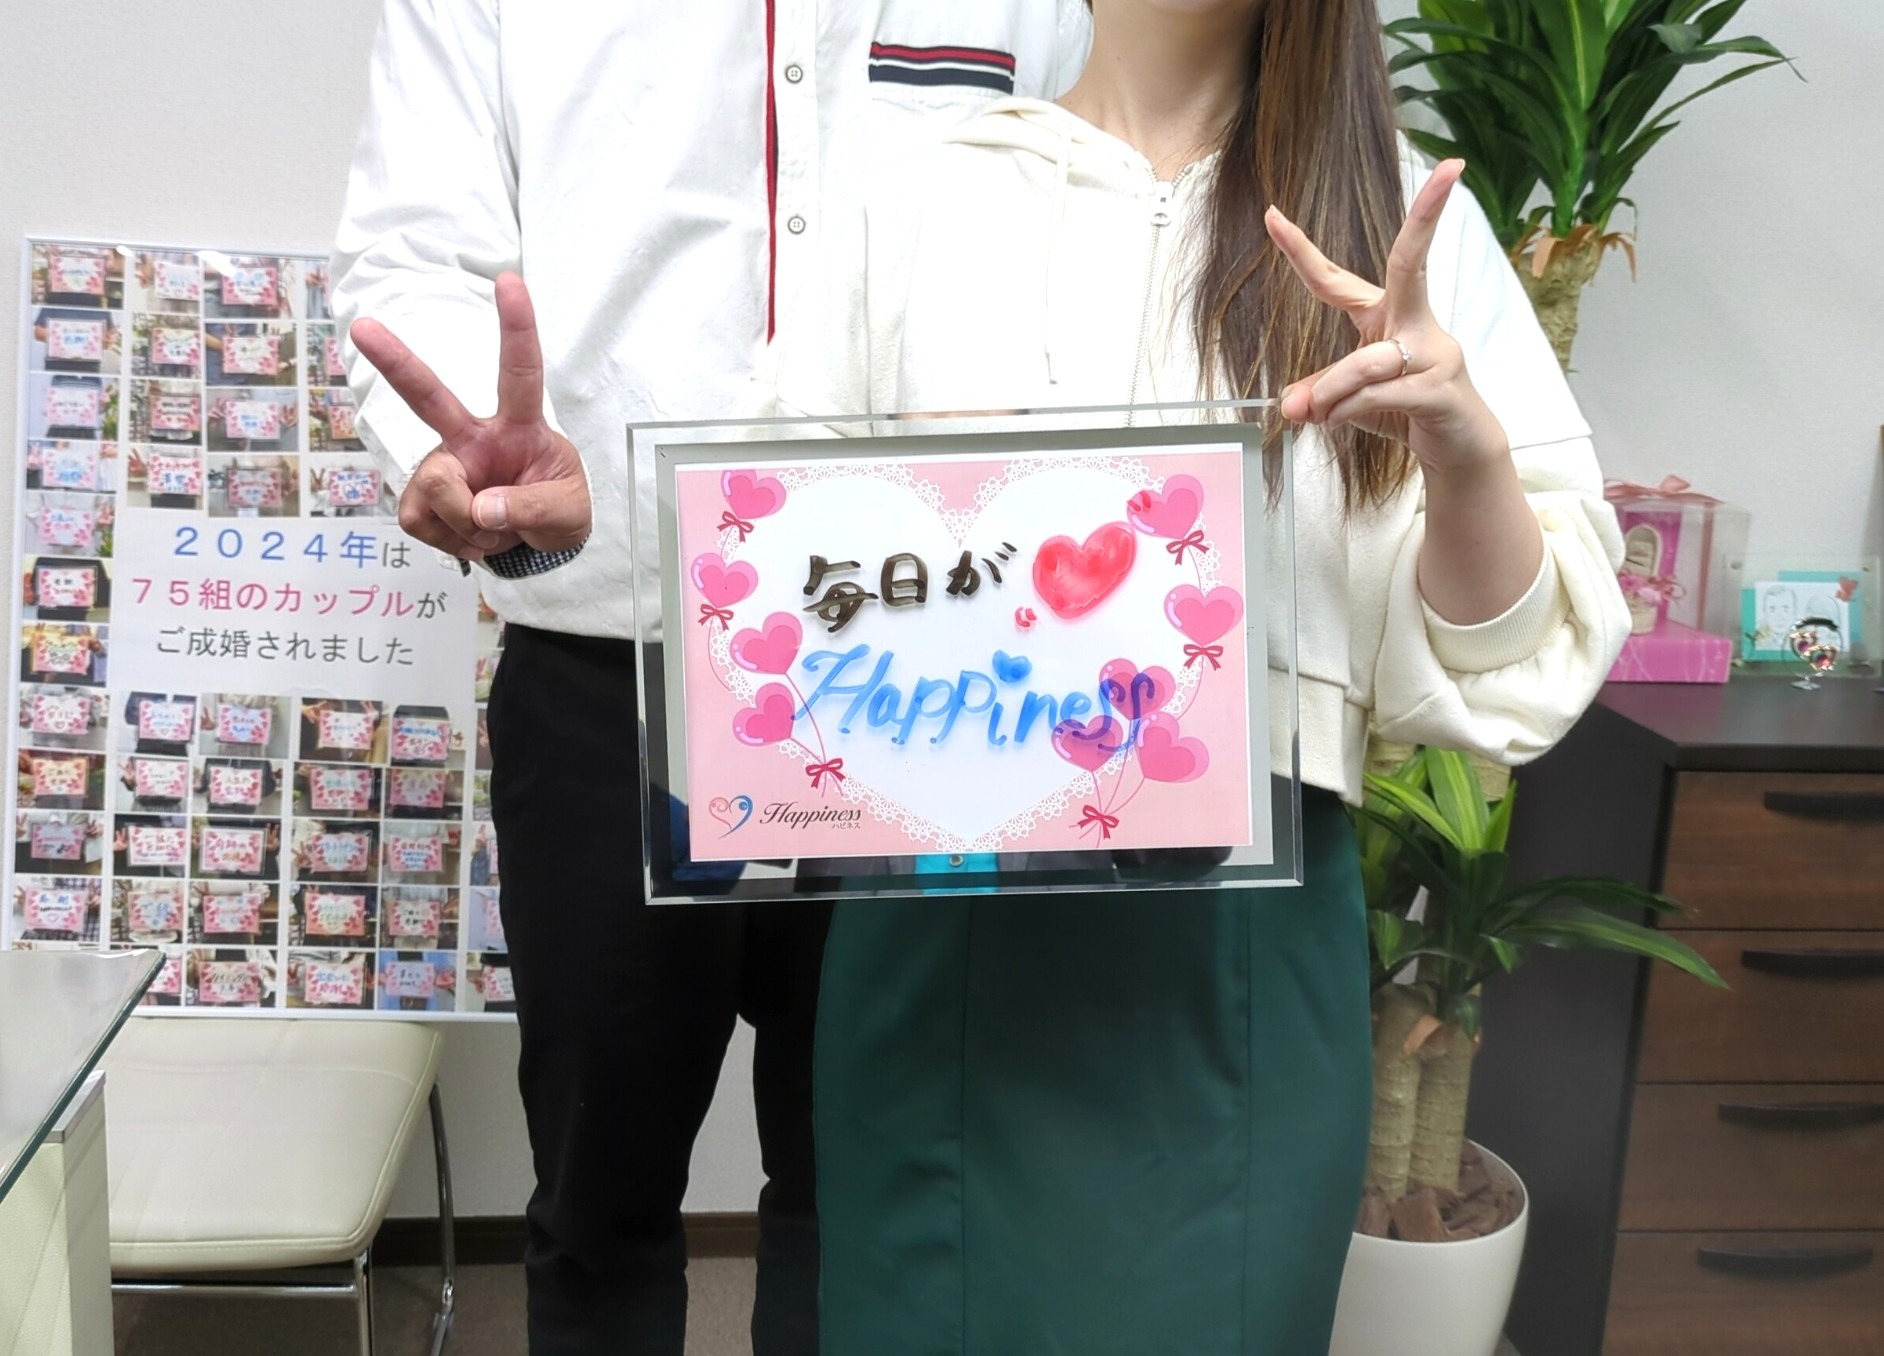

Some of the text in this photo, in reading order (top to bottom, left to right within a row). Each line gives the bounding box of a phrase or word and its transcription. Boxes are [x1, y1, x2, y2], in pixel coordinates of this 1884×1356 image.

[803, 541, 1018, 634] 毎日が
[156, 625, 415, 666] ご成婚されました
[790, 643, 1156, 754] Happiness
[759, 800, 862, 830] Happiness
